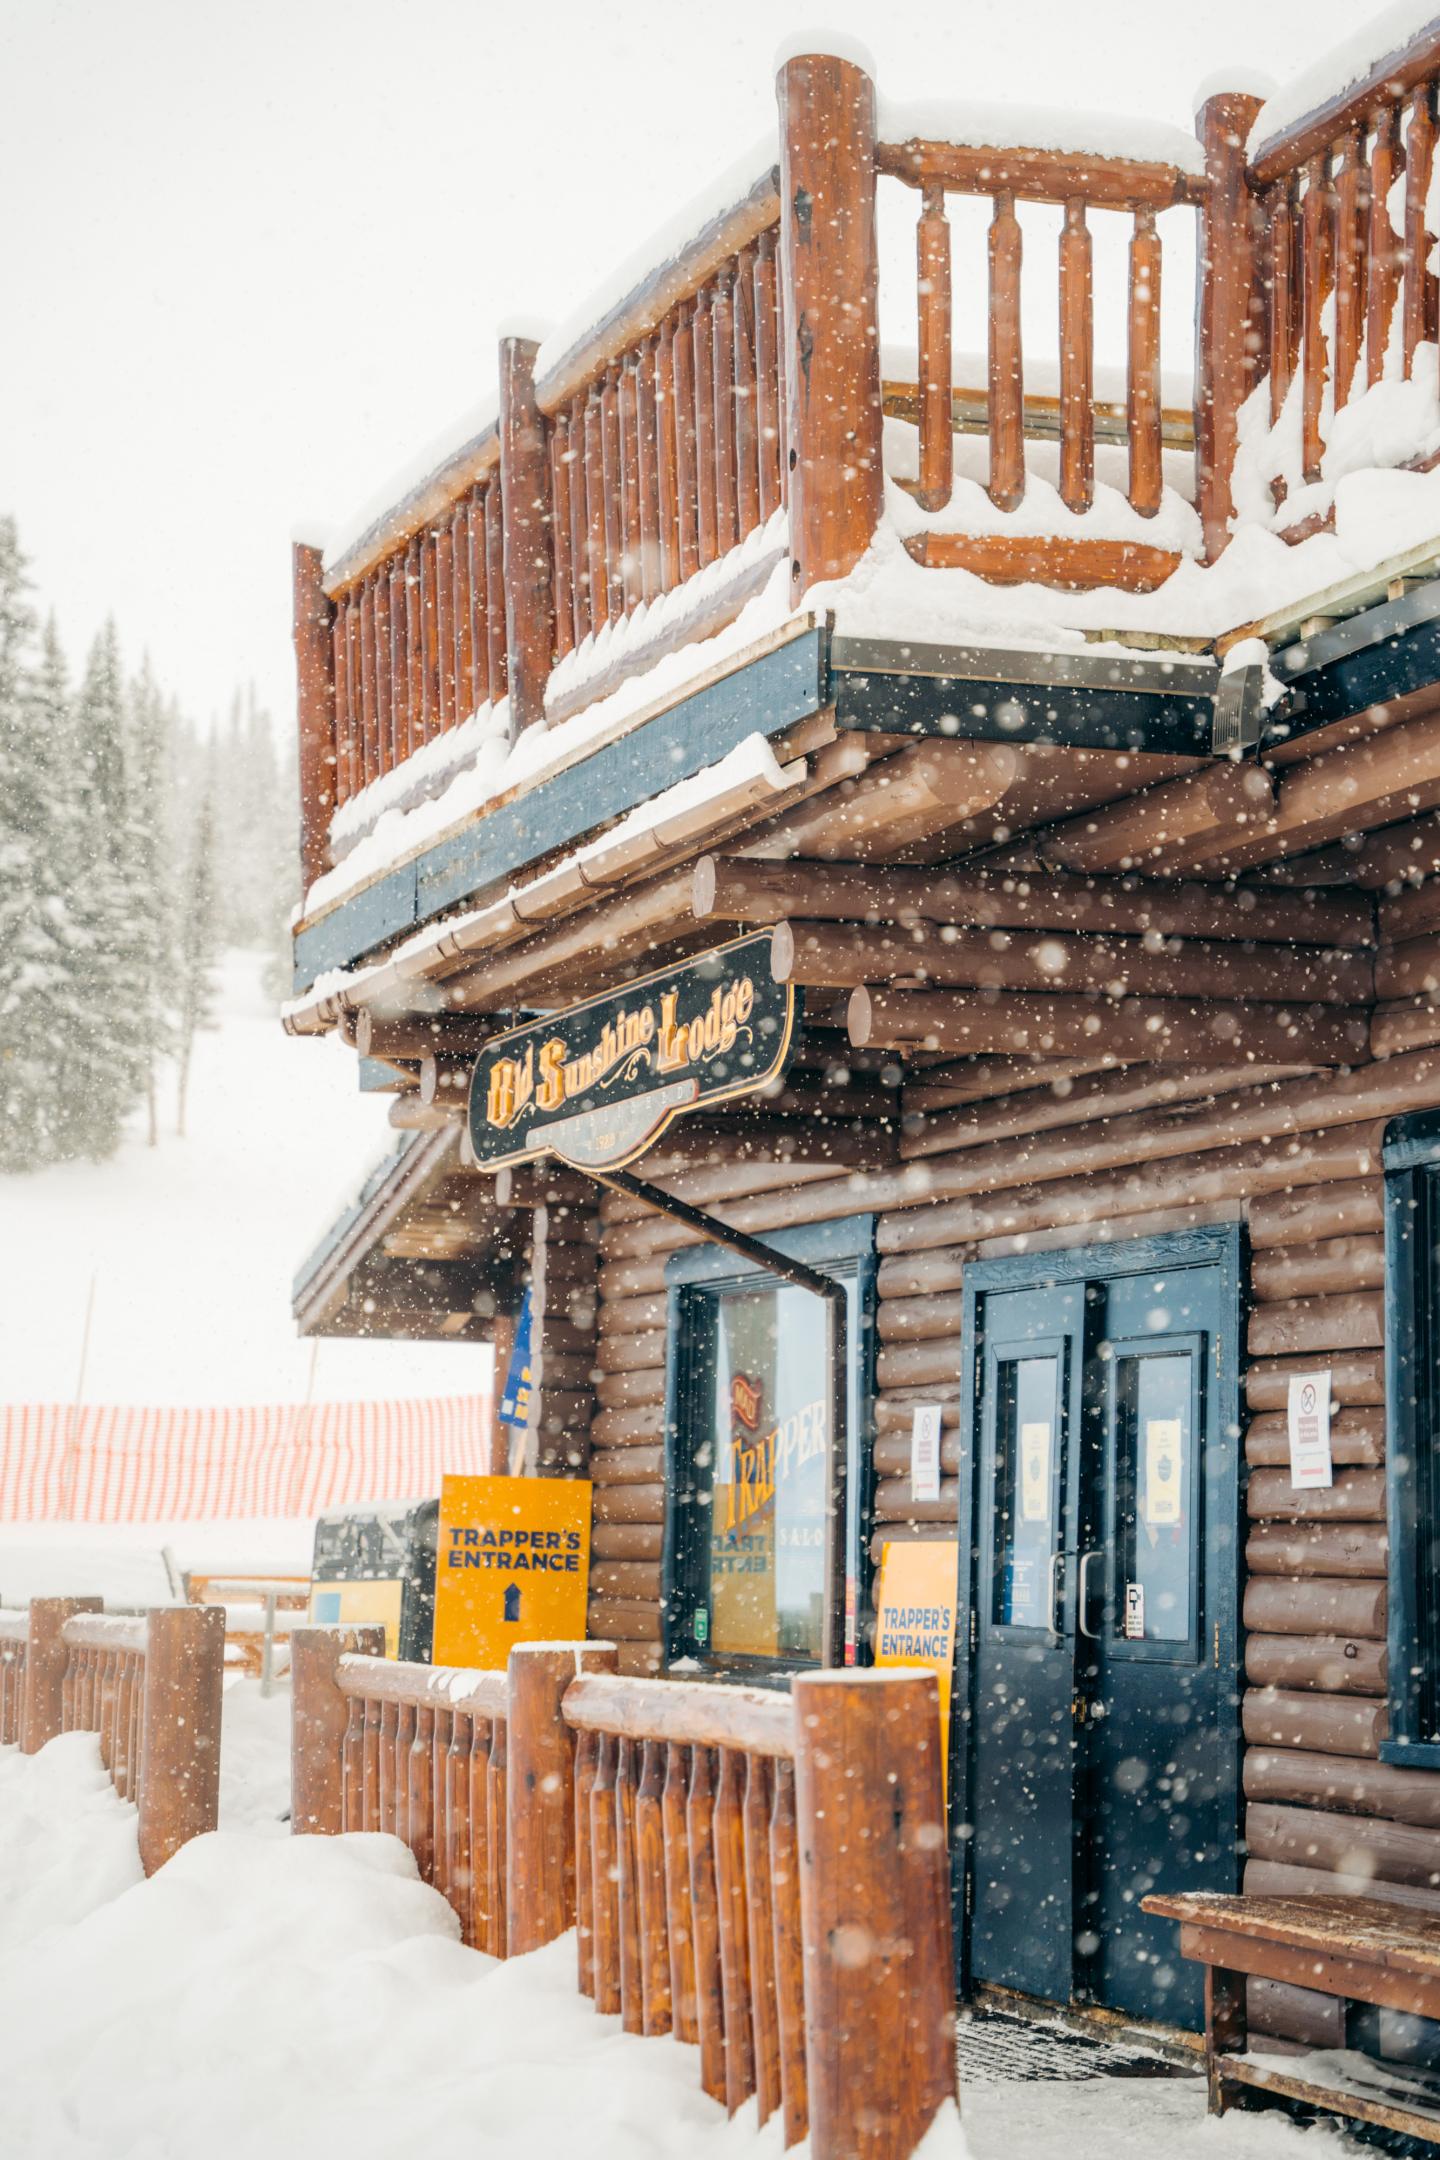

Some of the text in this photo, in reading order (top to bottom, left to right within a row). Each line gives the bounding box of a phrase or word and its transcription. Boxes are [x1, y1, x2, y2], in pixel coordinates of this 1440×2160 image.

[536, 1006, 655, 1112] Sunshine
[656, 976, 754, 1074] Lodge
[449, 1528, 581, 1550] TRAPPER'S
[447, 1550, 580, 1572] ENTRANCE
[883, 1604, 951, 1631] TRAPPER'S
[881, 1633, 949, 1659] ENTRANCE
